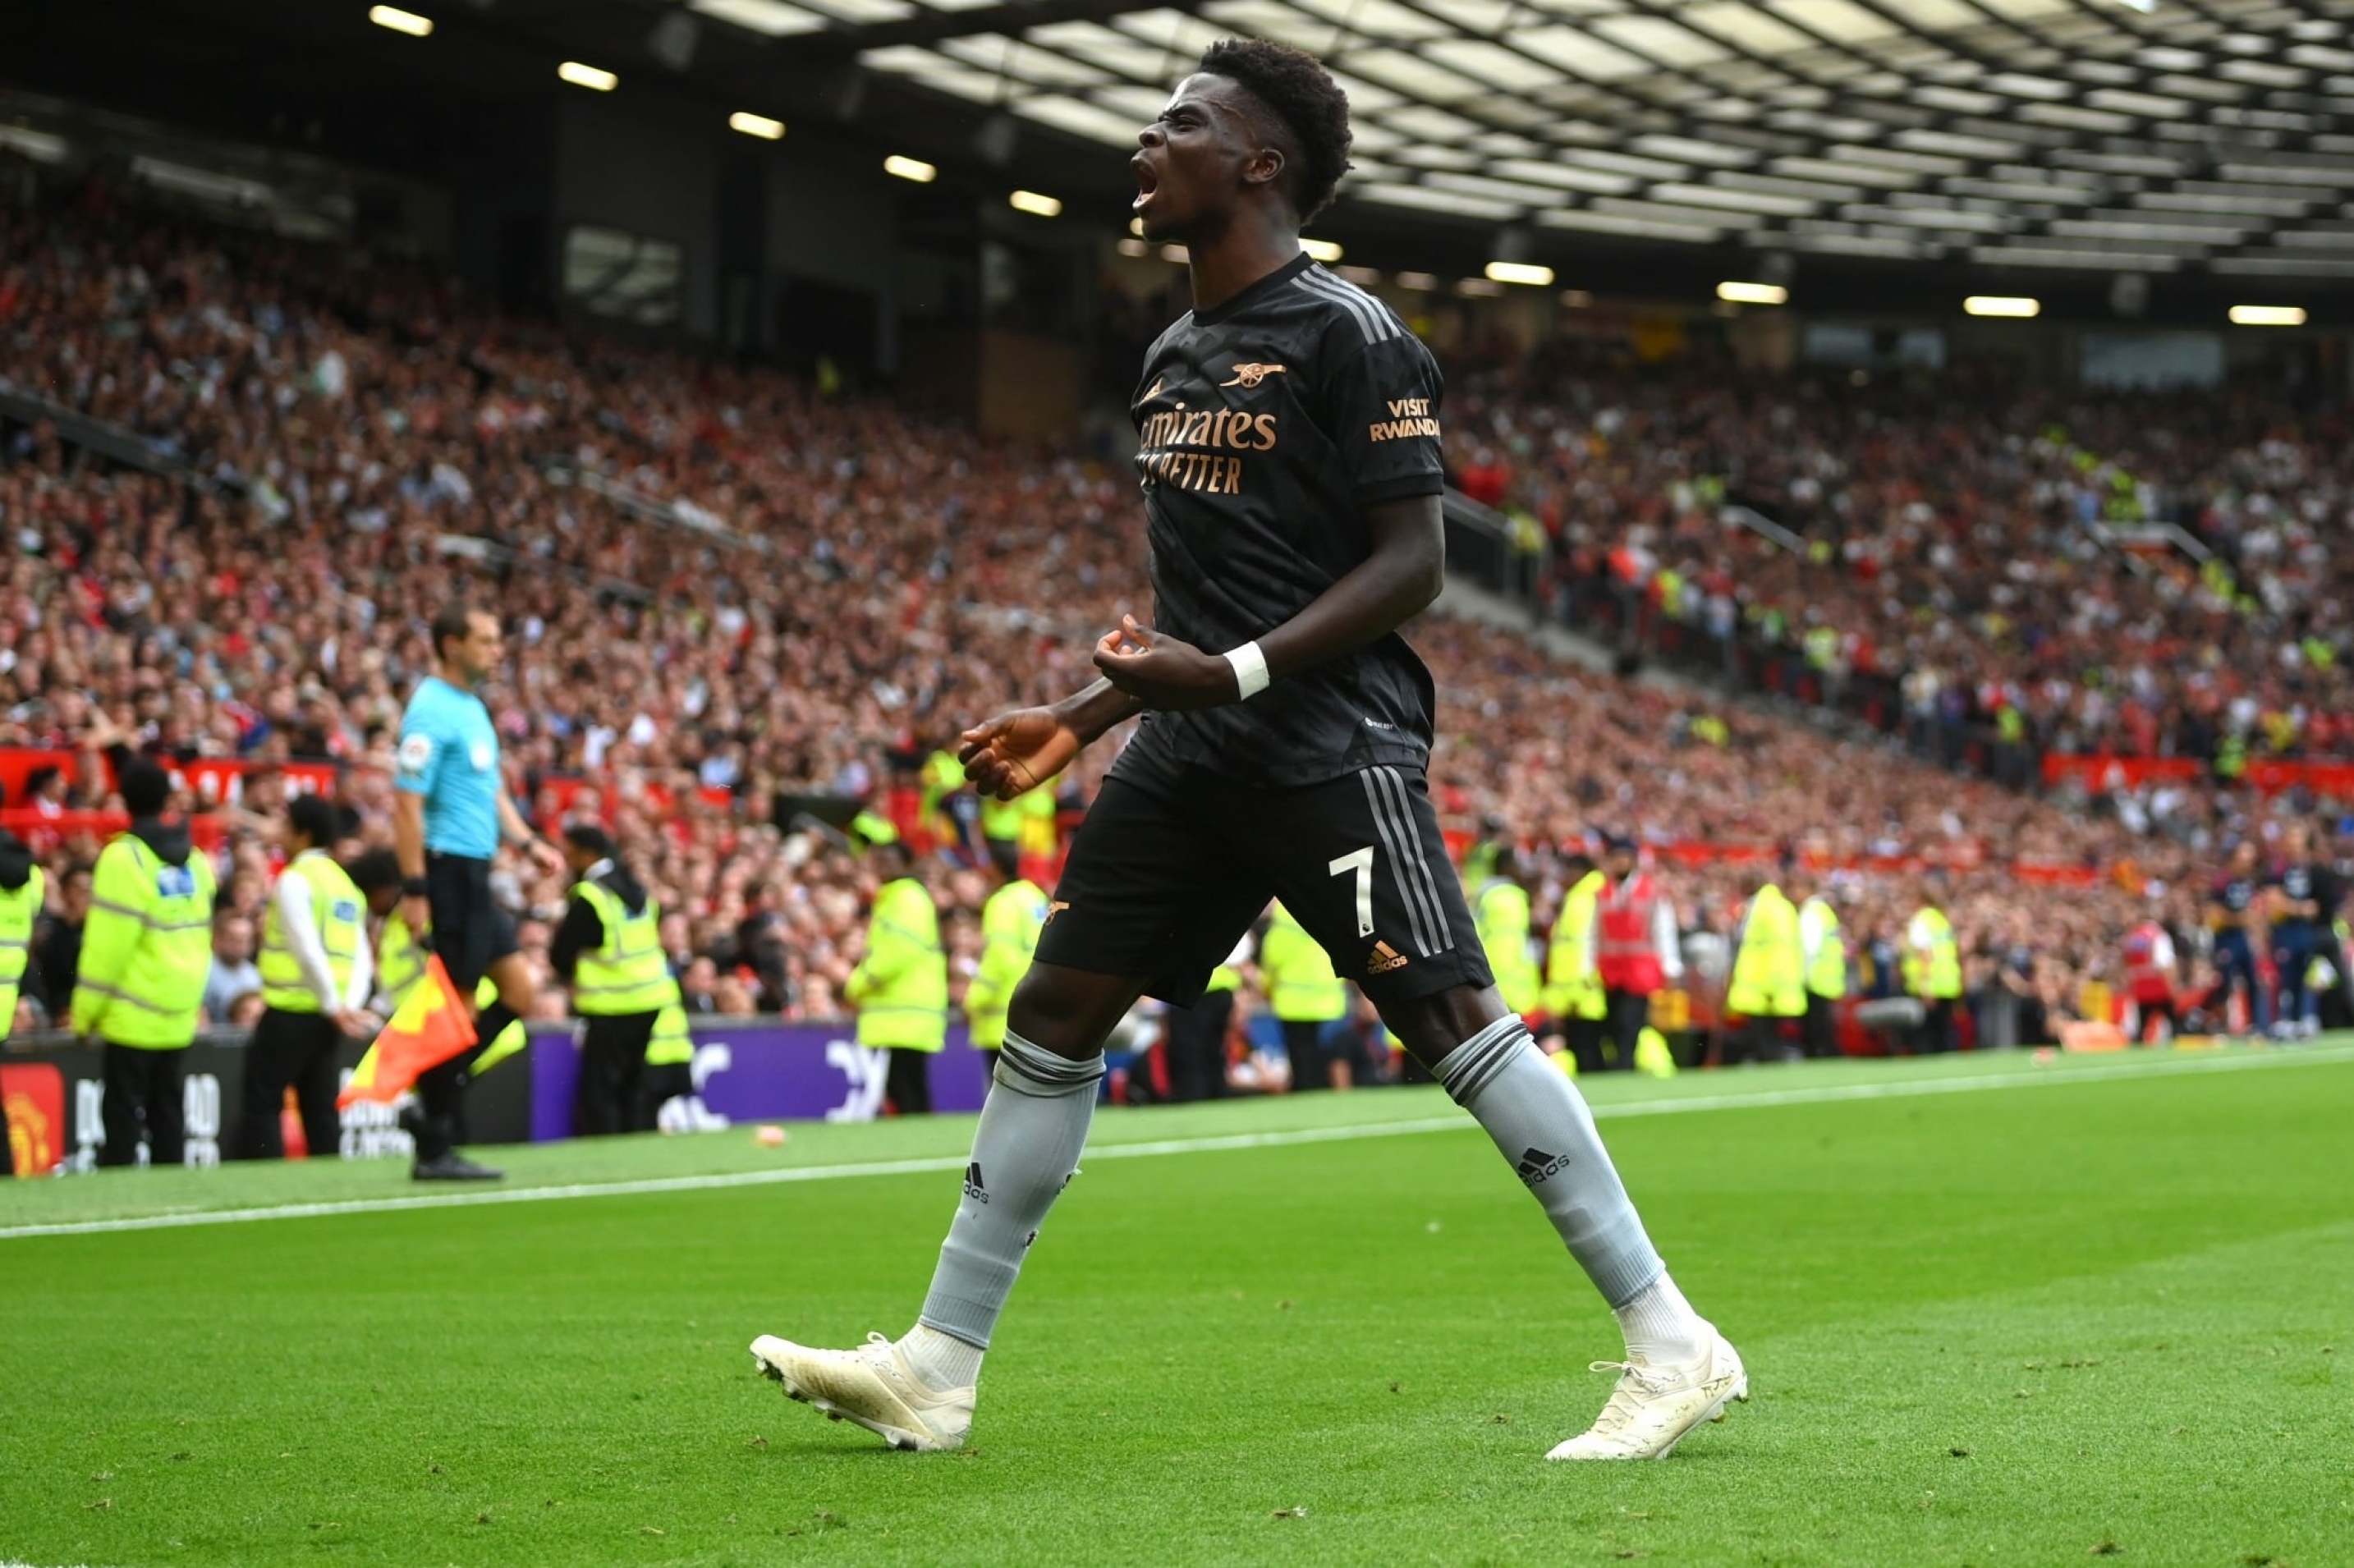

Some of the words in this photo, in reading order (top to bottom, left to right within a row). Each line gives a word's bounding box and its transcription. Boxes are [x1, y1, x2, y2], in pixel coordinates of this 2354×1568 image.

[1387, 397, 1429, 417] VISIT
[1328, 846, 1374, 938] 7
[1367, 955, 1408, 974] adidas
